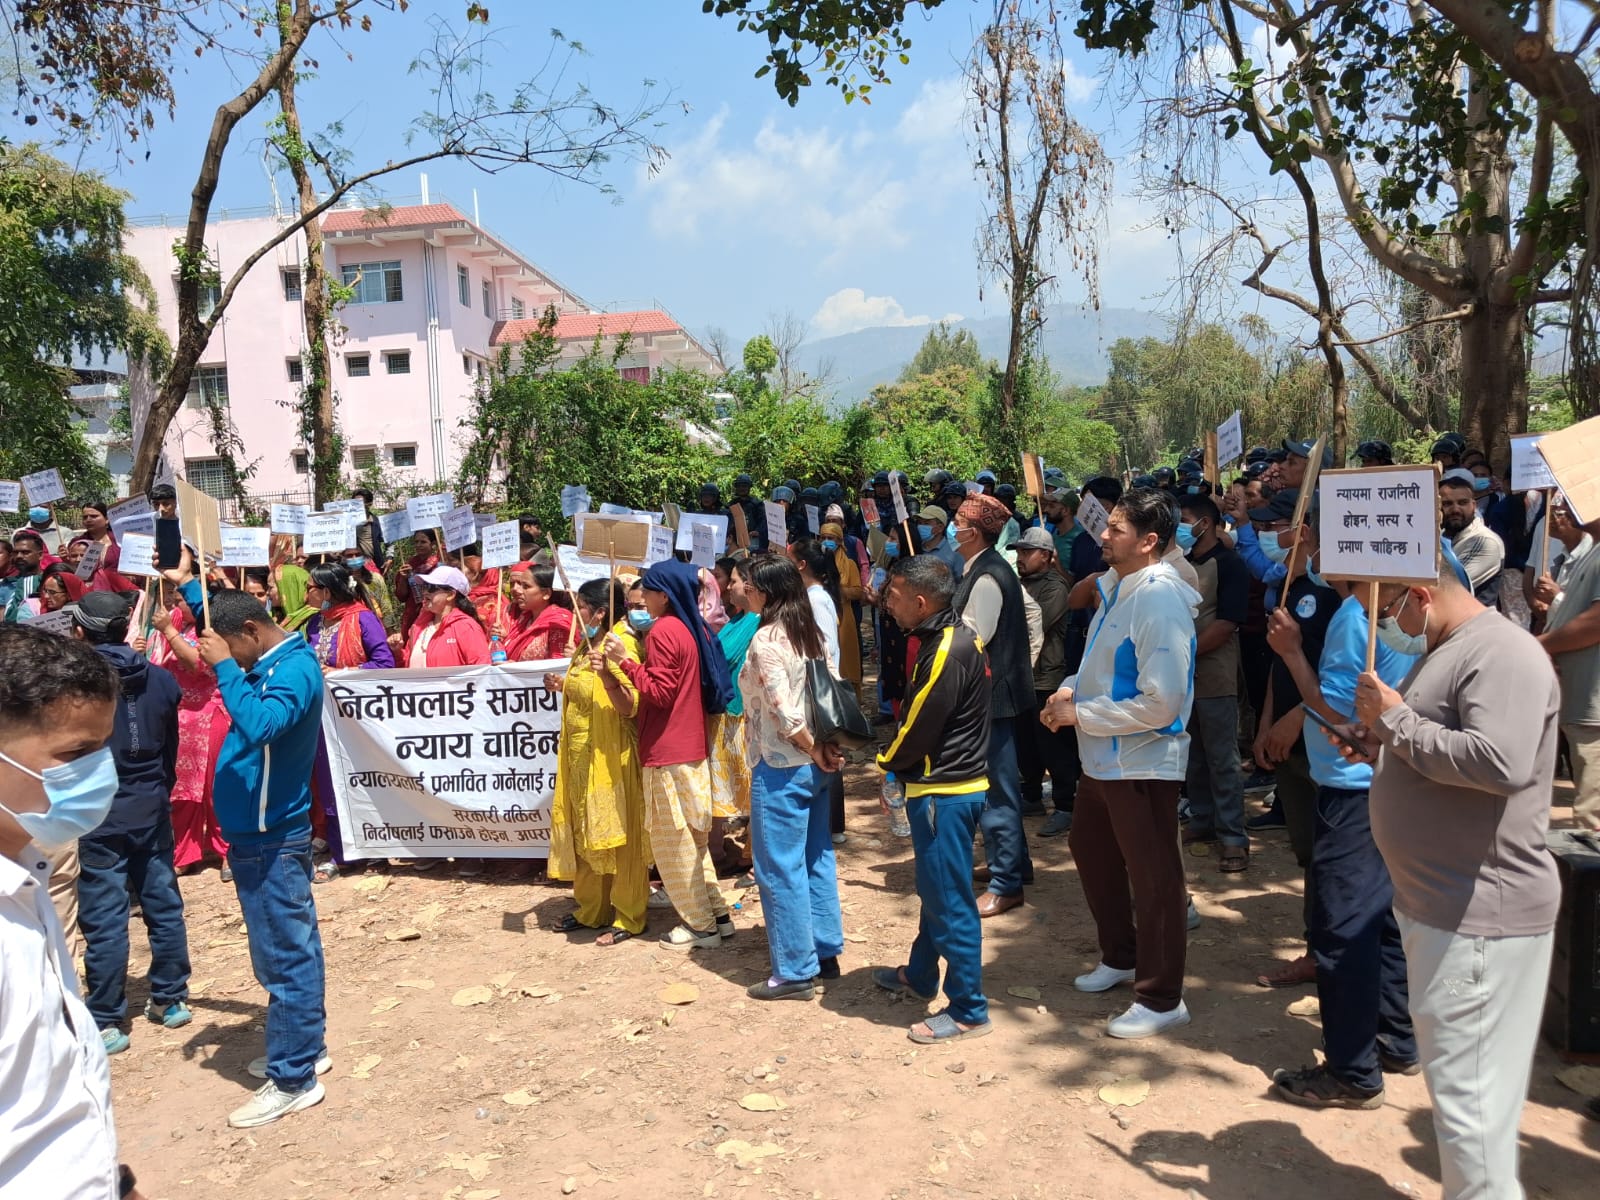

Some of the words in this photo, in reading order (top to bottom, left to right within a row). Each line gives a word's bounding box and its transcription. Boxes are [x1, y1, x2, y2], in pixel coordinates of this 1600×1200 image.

[1336, 488, 1371, 501] न्यायमा
[1377, 482, 1420, 501] राजनिती
[1376, 514, 1400, 527] सत्य
[1407, 514, 1414, 528] र
[1338, 540, 1363, 554] प्रमाण
[1370, 537, 1408, 555] चाहिन्छ
[330, 682, 476, 722] निर्दोषलाई
[396, 733, 473, 760] न्याय
[431, 768, 487, 795] प्रभावित
[492, 768, 544, 796] गर्नेलाई
[452, 805, 499, 824] सरकारी
[503, 804, 542, 823] वकिल
[362, 822, 425, 842] निर्दोषलाई
[429, 824, 475, 841] फसाउने
[517, 828, 551, 842] अपरा
